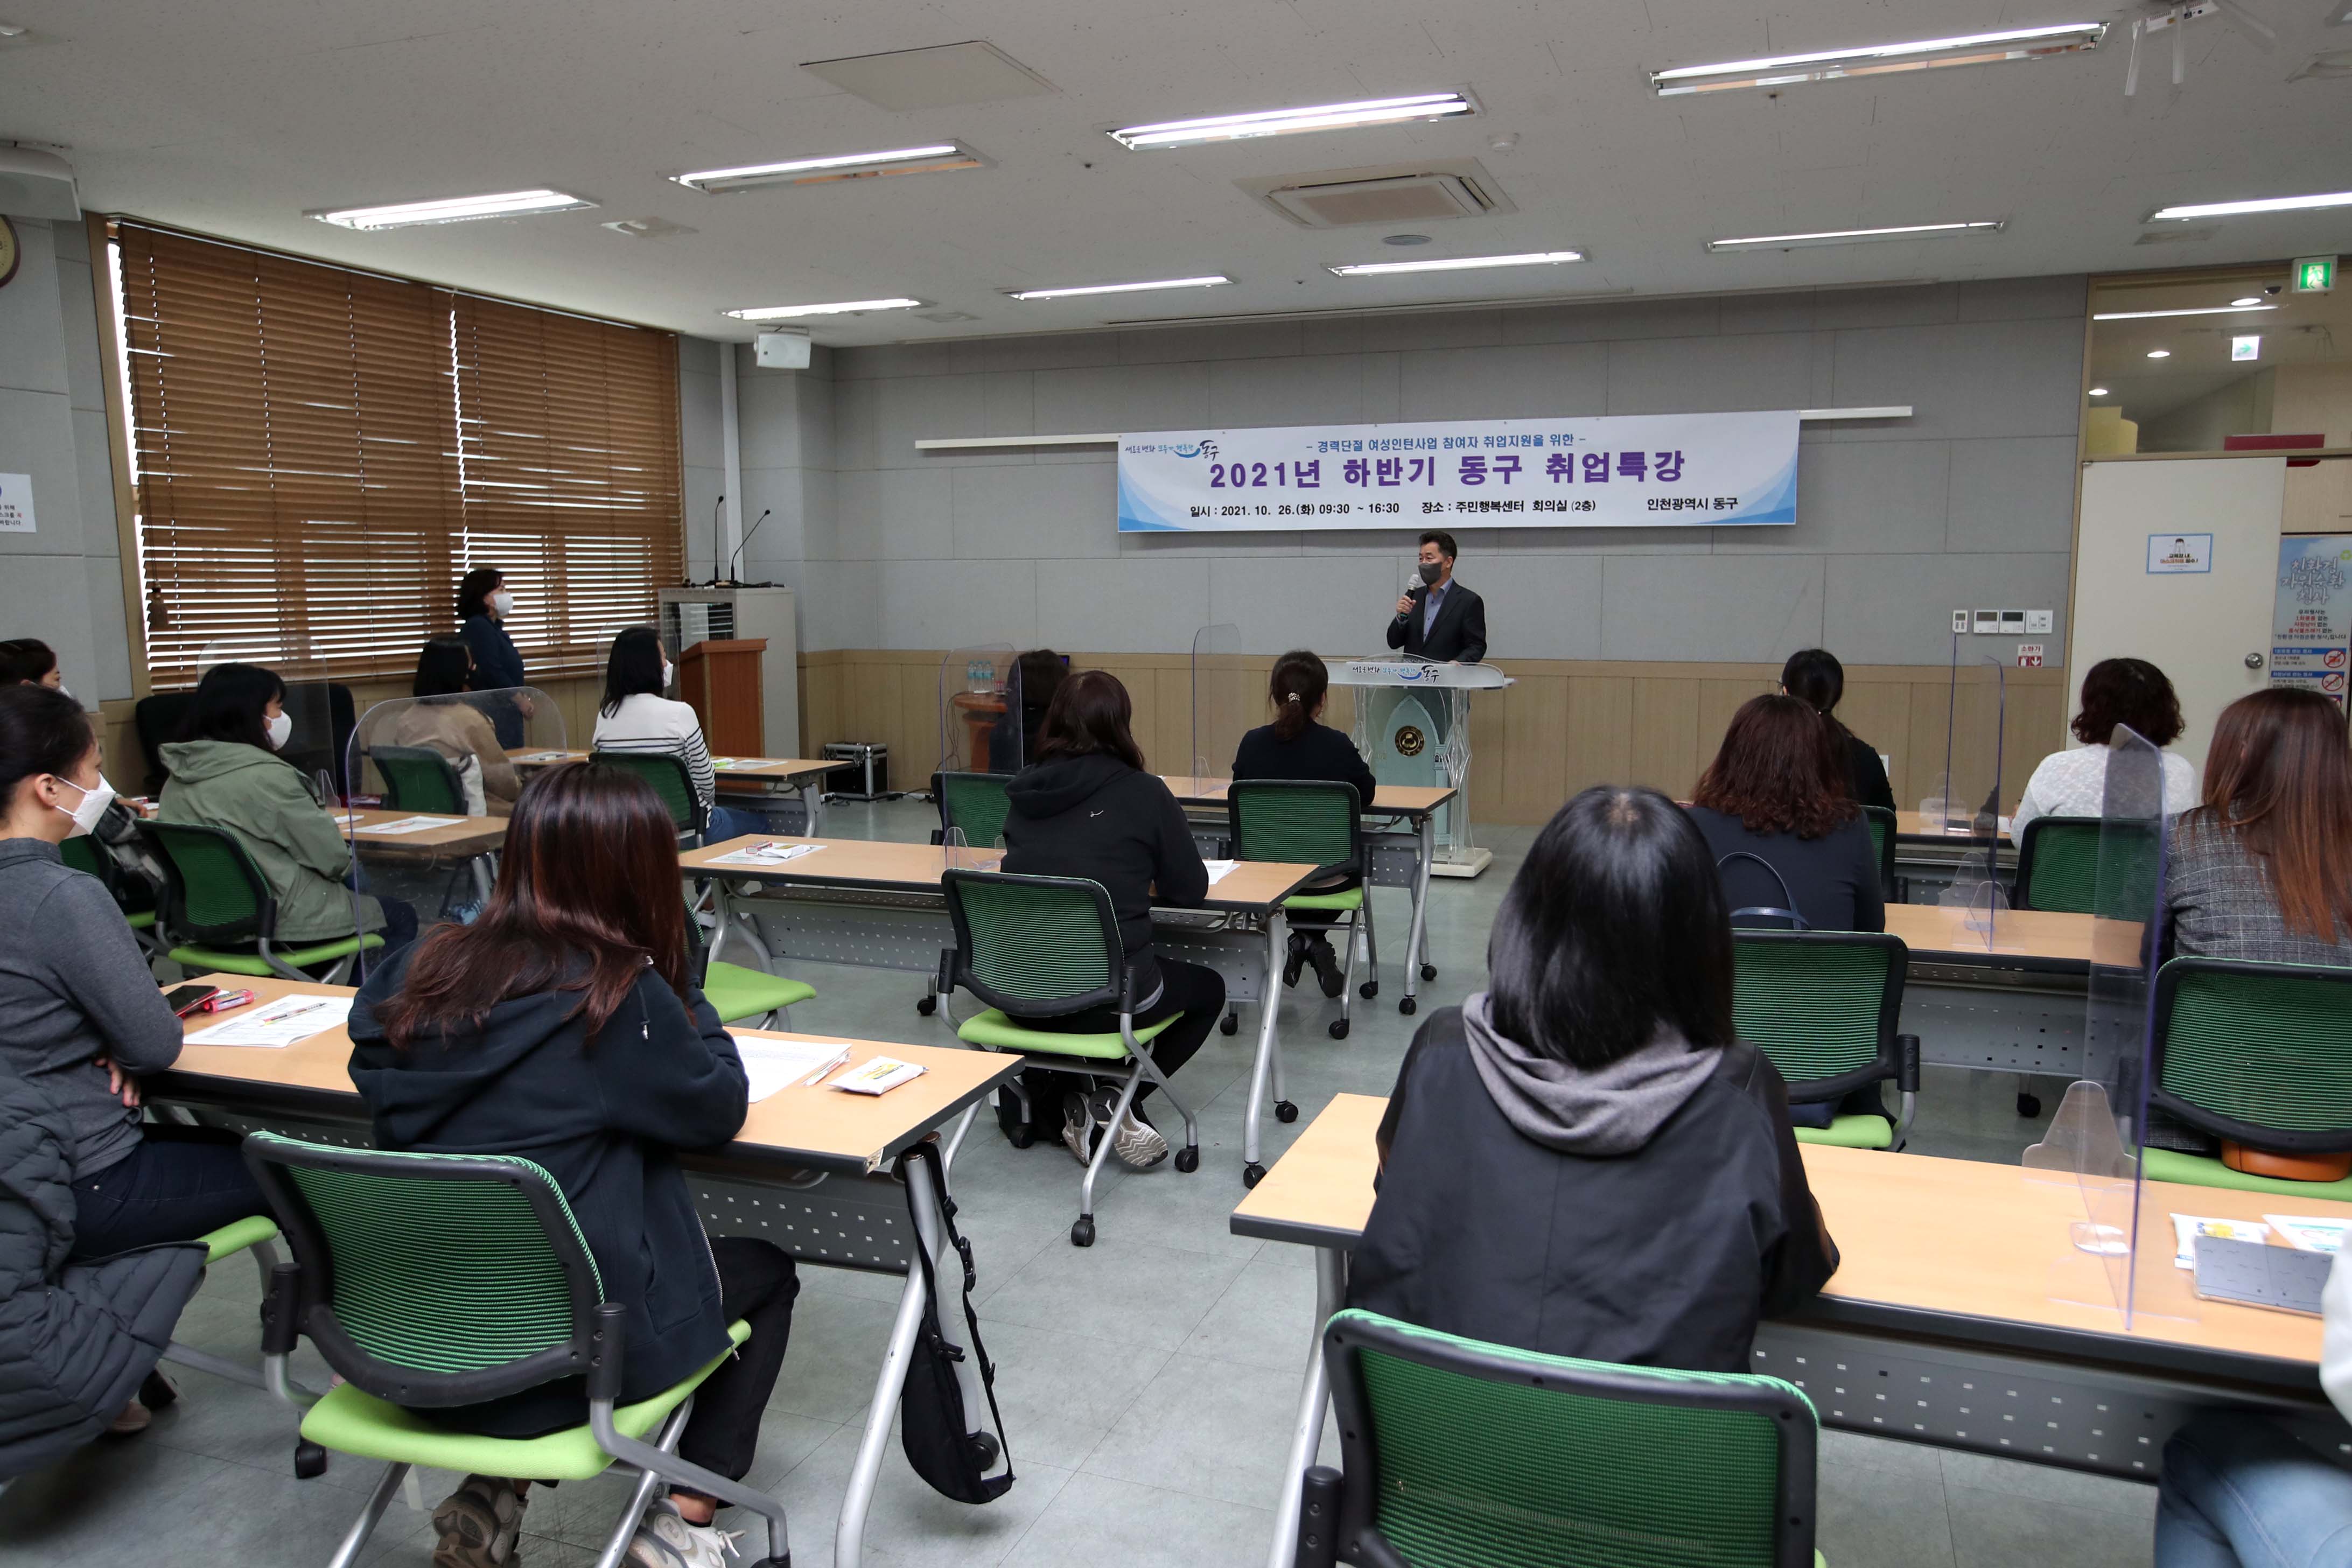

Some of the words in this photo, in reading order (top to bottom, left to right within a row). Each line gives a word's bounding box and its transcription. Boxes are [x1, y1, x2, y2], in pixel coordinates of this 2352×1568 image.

[1200, 439, 1220, 461] 동구
[1318, 439, 1363, 453] 경력단절
[1368, 437, 1437, 451] 여성인턴사업
[1443, 436, 1479, 449] 참여자
[1483, 434, 1544, 448] 취업지원을
[1550, 433, 1574, 446] 위한
[1210, 459, 1320, 488] 2021년
[1343, 456, 1434, 487] 하반기
[1458, 455, 1522, 486] 동구
[1546, 450, 1685, 484] 취업특강
[1255, 505, 1271, 515] 10.
[1319, 503, 1350, 514] 09:30
[1368, 502, 1399, 513] 16:30
[1455, 500, 1524, 513] 주민행복센터
[1532, 499, 1567, 512] 회의실
[1571, 500, 1596, 512] (2층)
[1647, 498, 1709, 511] 인천광역시
[1712, 497, 1739, 510] 동구
